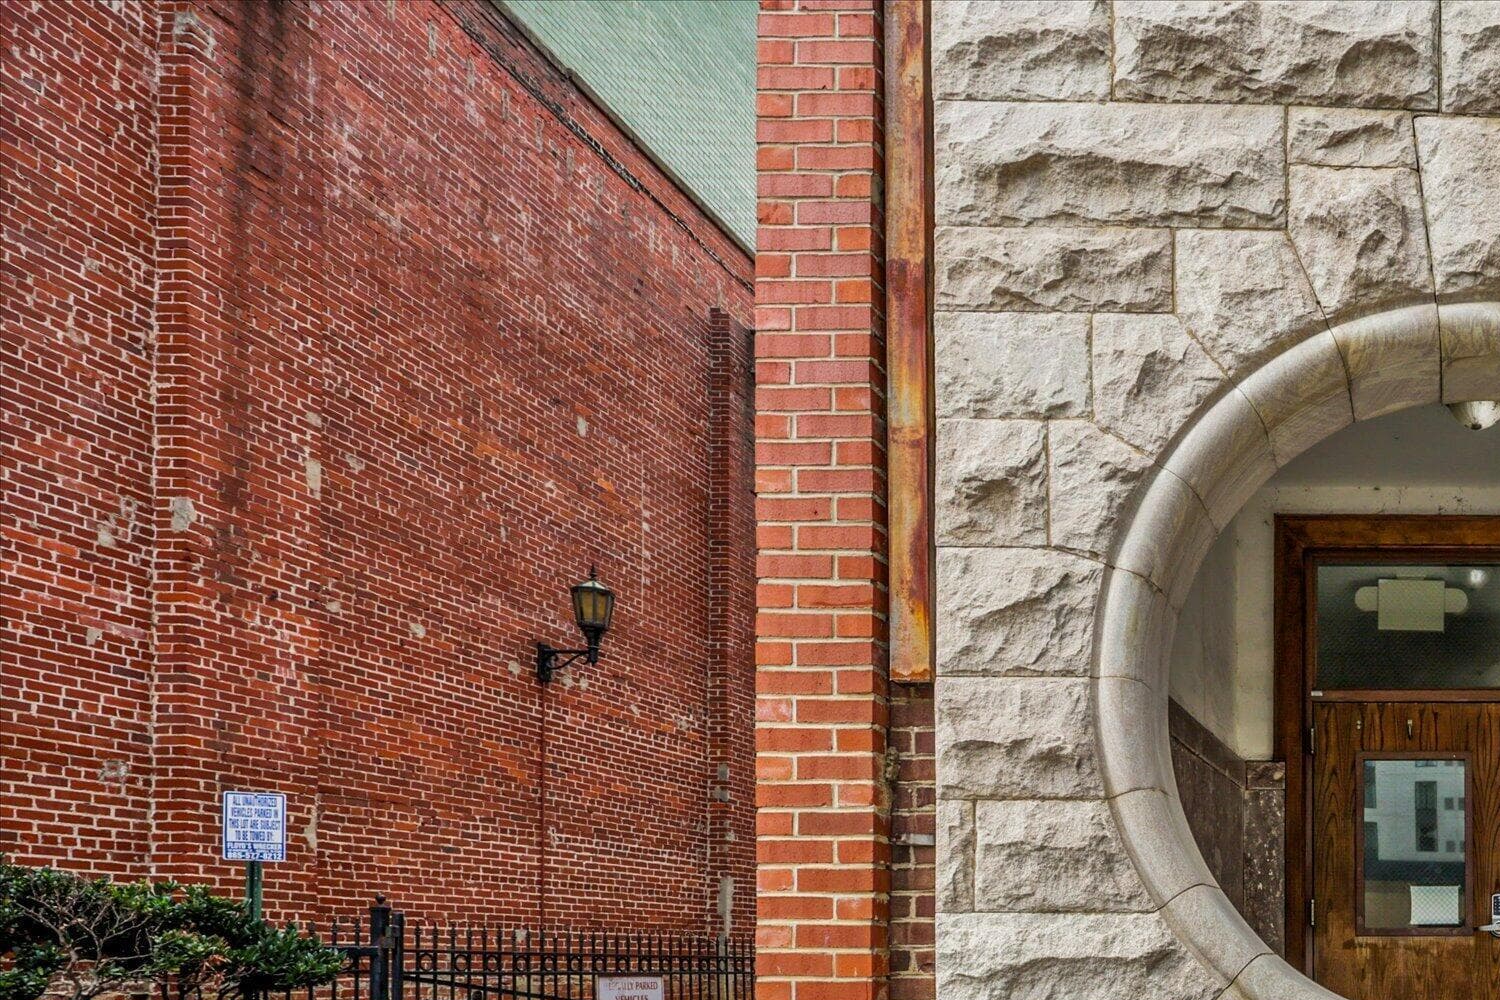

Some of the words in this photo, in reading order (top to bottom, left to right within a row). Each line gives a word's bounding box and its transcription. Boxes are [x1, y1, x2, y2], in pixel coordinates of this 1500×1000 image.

[232, 796, 241, 806] ALL
[241, 796, 278, 808] UNAUTHORIZED
[231, 807, 253, 818] VEHICLES
[254, 808, 273, 819] PARKED
[229, 818, 240, 829] THIS
[240, 818, 249, 829] LOT
[250, 819, 259, 830] ARE
[260, 819, 281, 831] SUBJECT
[235, 830, 241, 841] TO
[242, 830, 249, 841] BE
[249, 831, 265, 841] TOWED
[635, 981, 658, 990] PARKED
